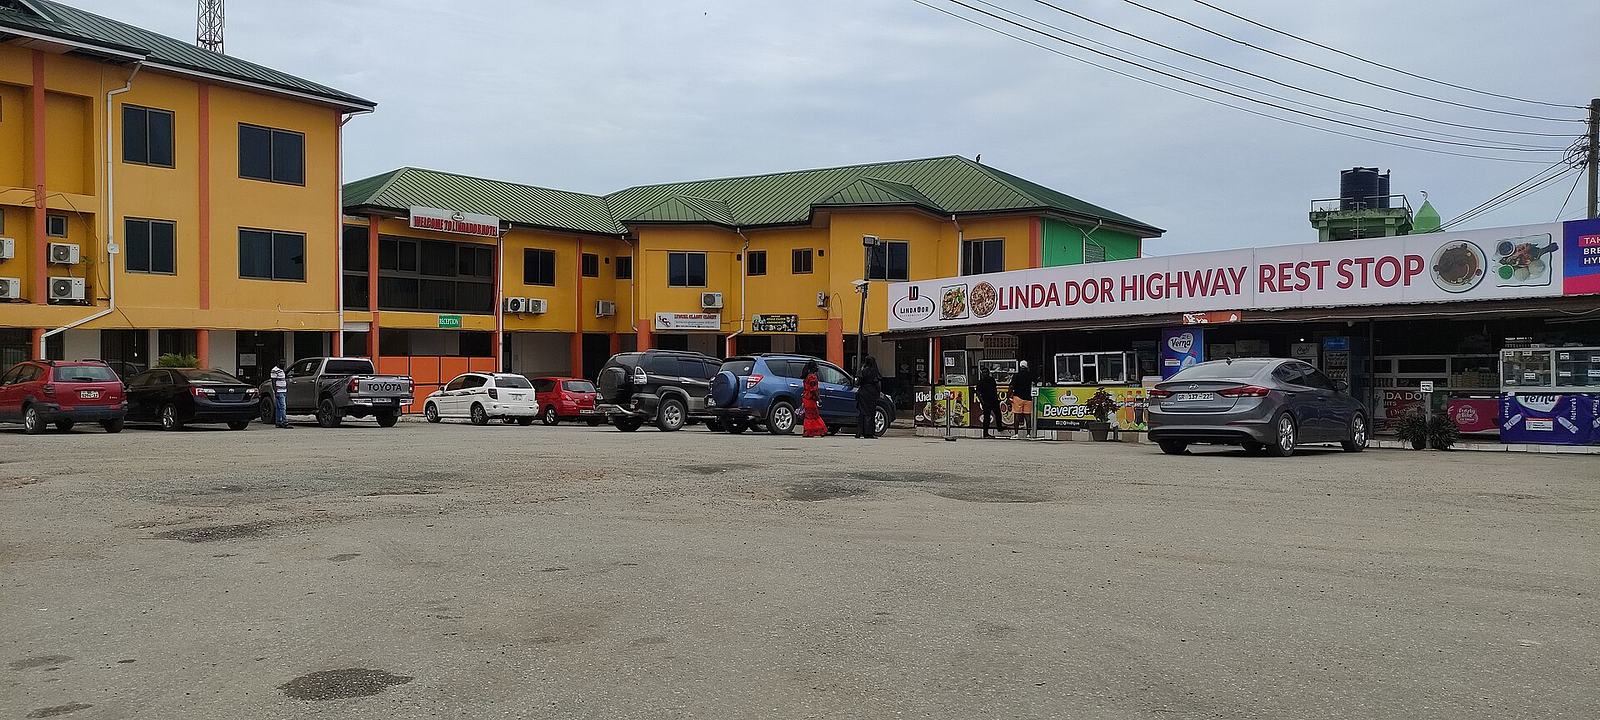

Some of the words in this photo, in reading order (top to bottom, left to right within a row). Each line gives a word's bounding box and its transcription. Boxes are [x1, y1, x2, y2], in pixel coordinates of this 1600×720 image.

[414, 216, 443, 230] WELCOME
[444, 220, 452, 231] TO
[998, 282, 1061, 310] LINDA
[1065, 277, 1115, 305] DOR
[1120, 266, 1248, 301] HIGHWAY
[1258, 260, 1331, 293] REST
[1336, 254, 1425, 290] STOP
[1170, 337, 1191, 349] Verna
[367, 383, 402, 391] TOYOTA
